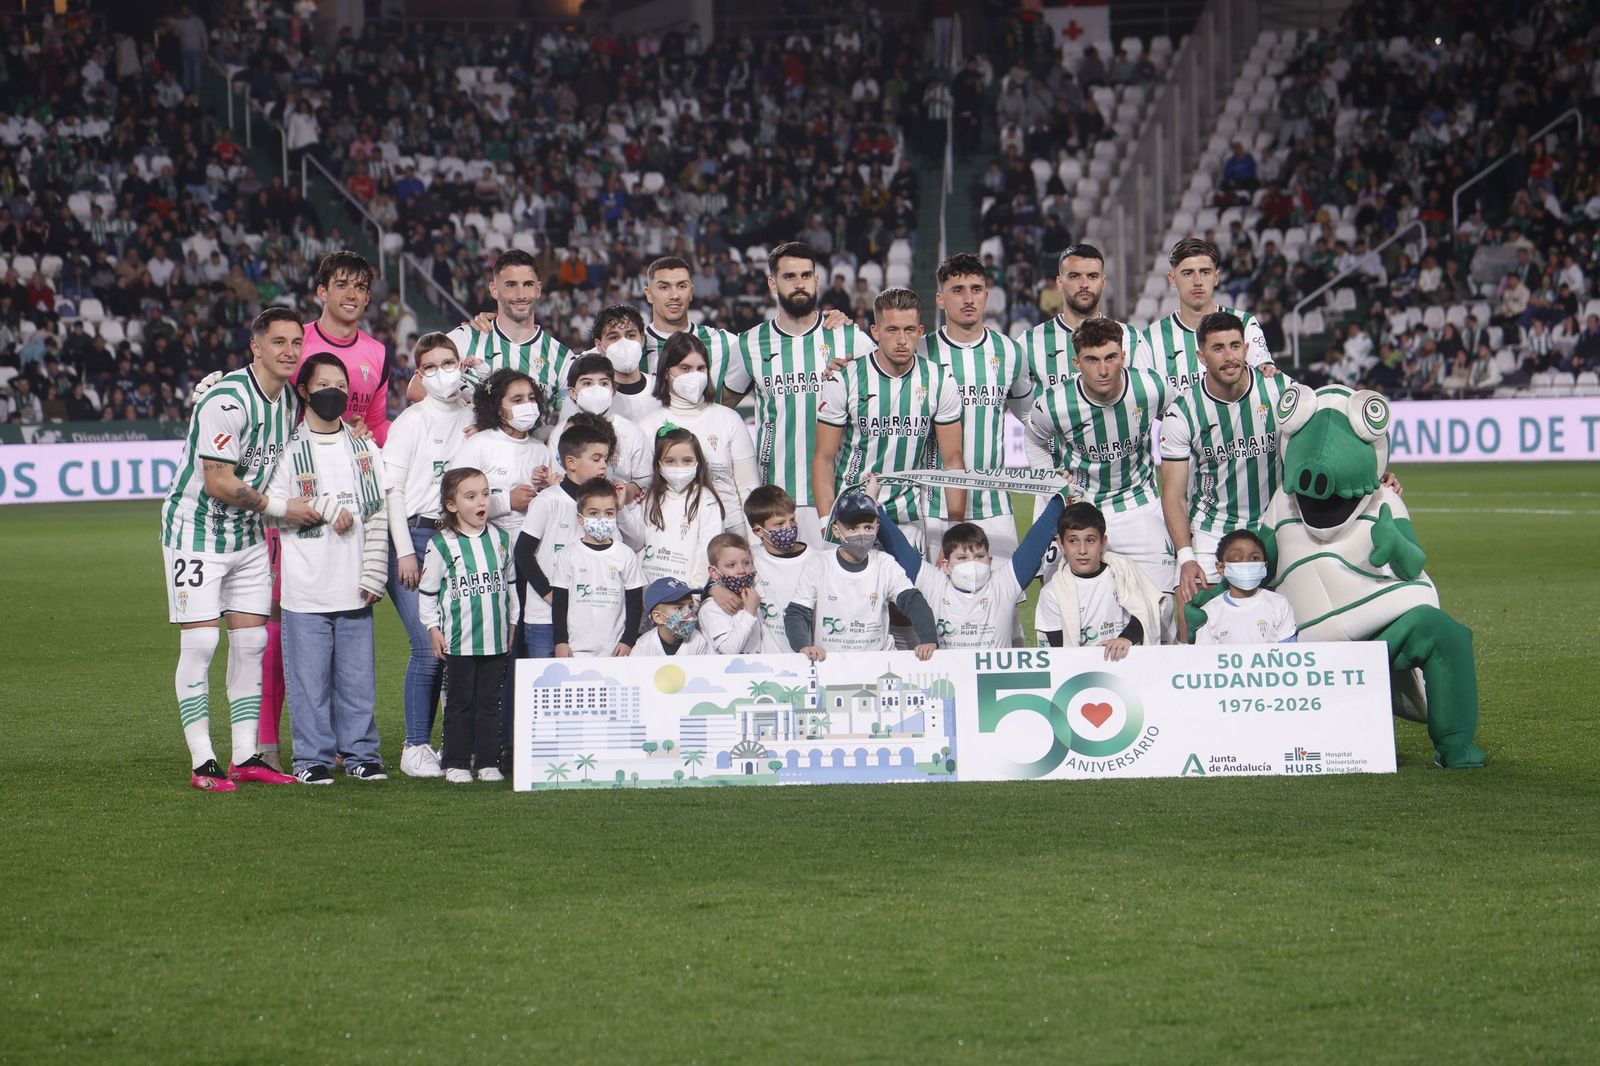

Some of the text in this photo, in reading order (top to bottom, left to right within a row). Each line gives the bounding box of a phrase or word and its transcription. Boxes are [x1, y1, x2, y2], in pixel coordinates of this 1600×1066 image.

[860, 416, 928, 428] BAHRAIN
[861, 428, 926, 437] VICTORIOUS
[1204, 432, 1276, 457] BAHRAIN
[1519, 416, 1565, 454] DE
[0, 462, 37, 498] S
[174, 558, 204, 587] 23
[975, 650, 1051, 670] HURS
[1217, 648, 1316, 669] 50 AÑOS
[1171, 669, 1366, 690] CUIDANDO DE TI
[1217, 697, 1322, 713] 1976-2026
[977, 671, 1145, 779] 50
[1066, 725, 1160, 773] ANIVERSARIO
[1209, 754, 1237, 763] Junta
[1208, 762, 1272, 773] de Andalucía
[1285, 763, 1323, 774] HURS
